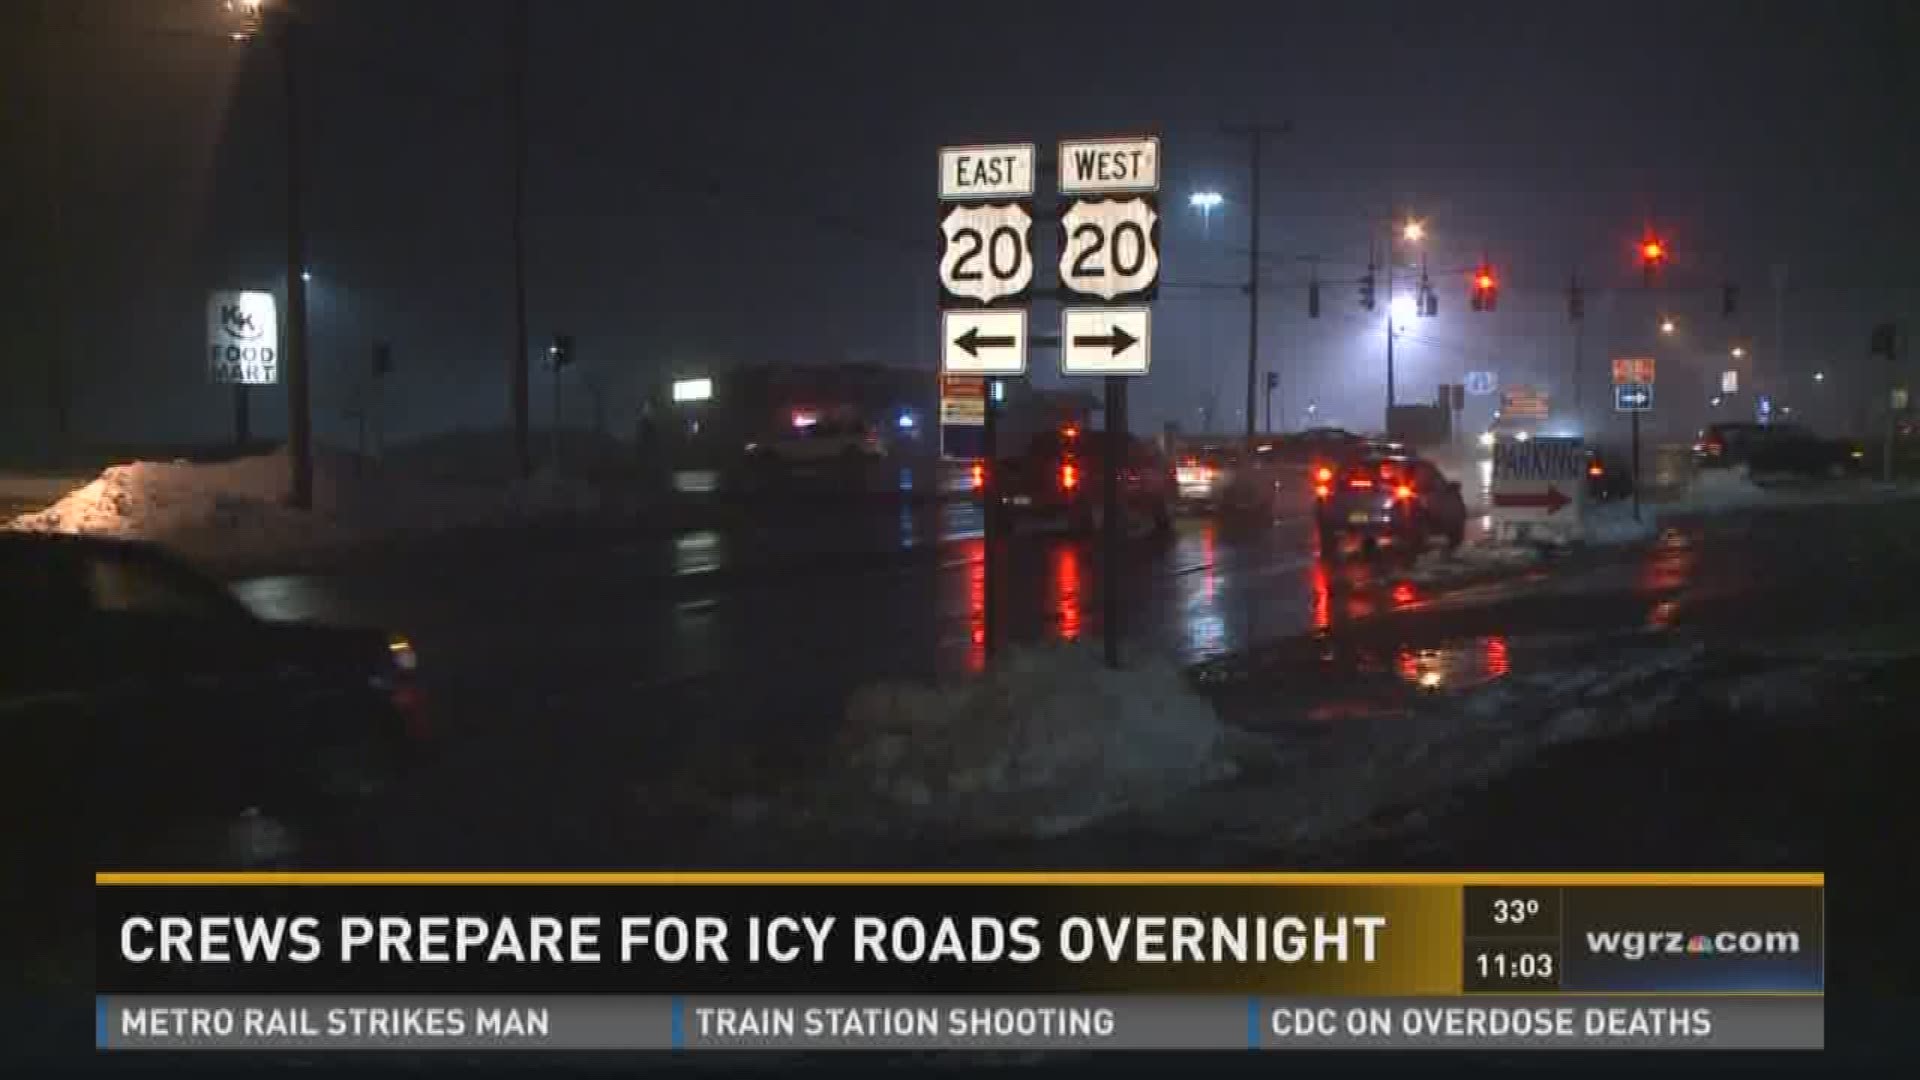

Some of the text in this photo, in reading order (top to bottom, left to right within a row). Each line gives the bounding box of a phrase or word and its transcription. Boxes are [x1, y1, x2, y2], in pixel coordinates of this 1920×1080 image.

[957, 156, 1016, 186] EAST
[1075, 150, 1142, 181] WEST
[951, 226, 1022, 281] 20
[1071, 221, 1146, 277] 20
[212, 345, 274, 362] FOOD
[1493, 440, 1582, 479] PARKING
